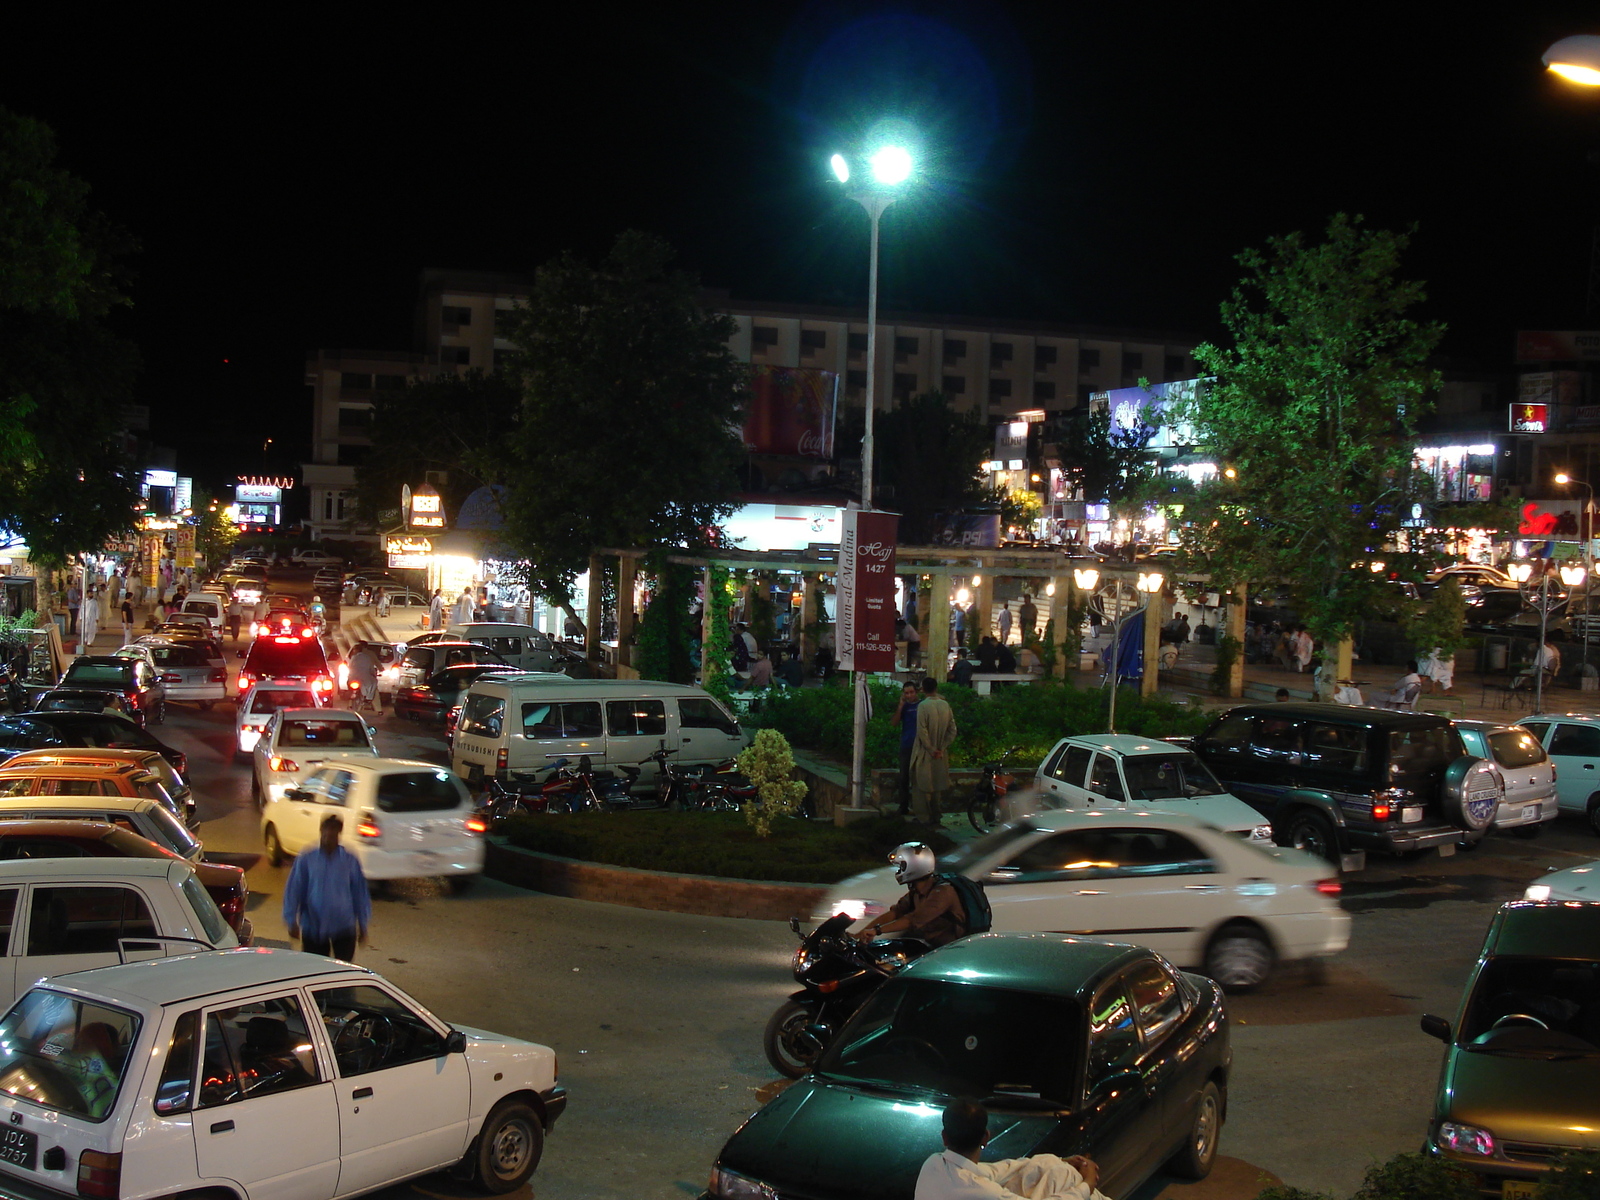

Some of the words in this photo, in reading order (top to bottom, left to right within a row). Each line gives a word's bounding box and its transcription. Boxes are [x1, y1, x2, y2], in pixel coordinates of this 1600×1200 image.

[857, 542, 894, 562] Hajj
[865, 564, 886, 573] 1427
[842, 529, 855, 658] Karwan-al-Madina
[866, 632, 880, 641] Call
[856, 642, 892, 652] 111-526-526
[457, 742, 495, 756] MITSUBISHI
[1469, 792, 1480, 801] LAND
[1480, 789, 1497, 799] CRUISER
[5, 1130, 26, 1147] IDL
[0, 1146, 28, 1164] 2757
